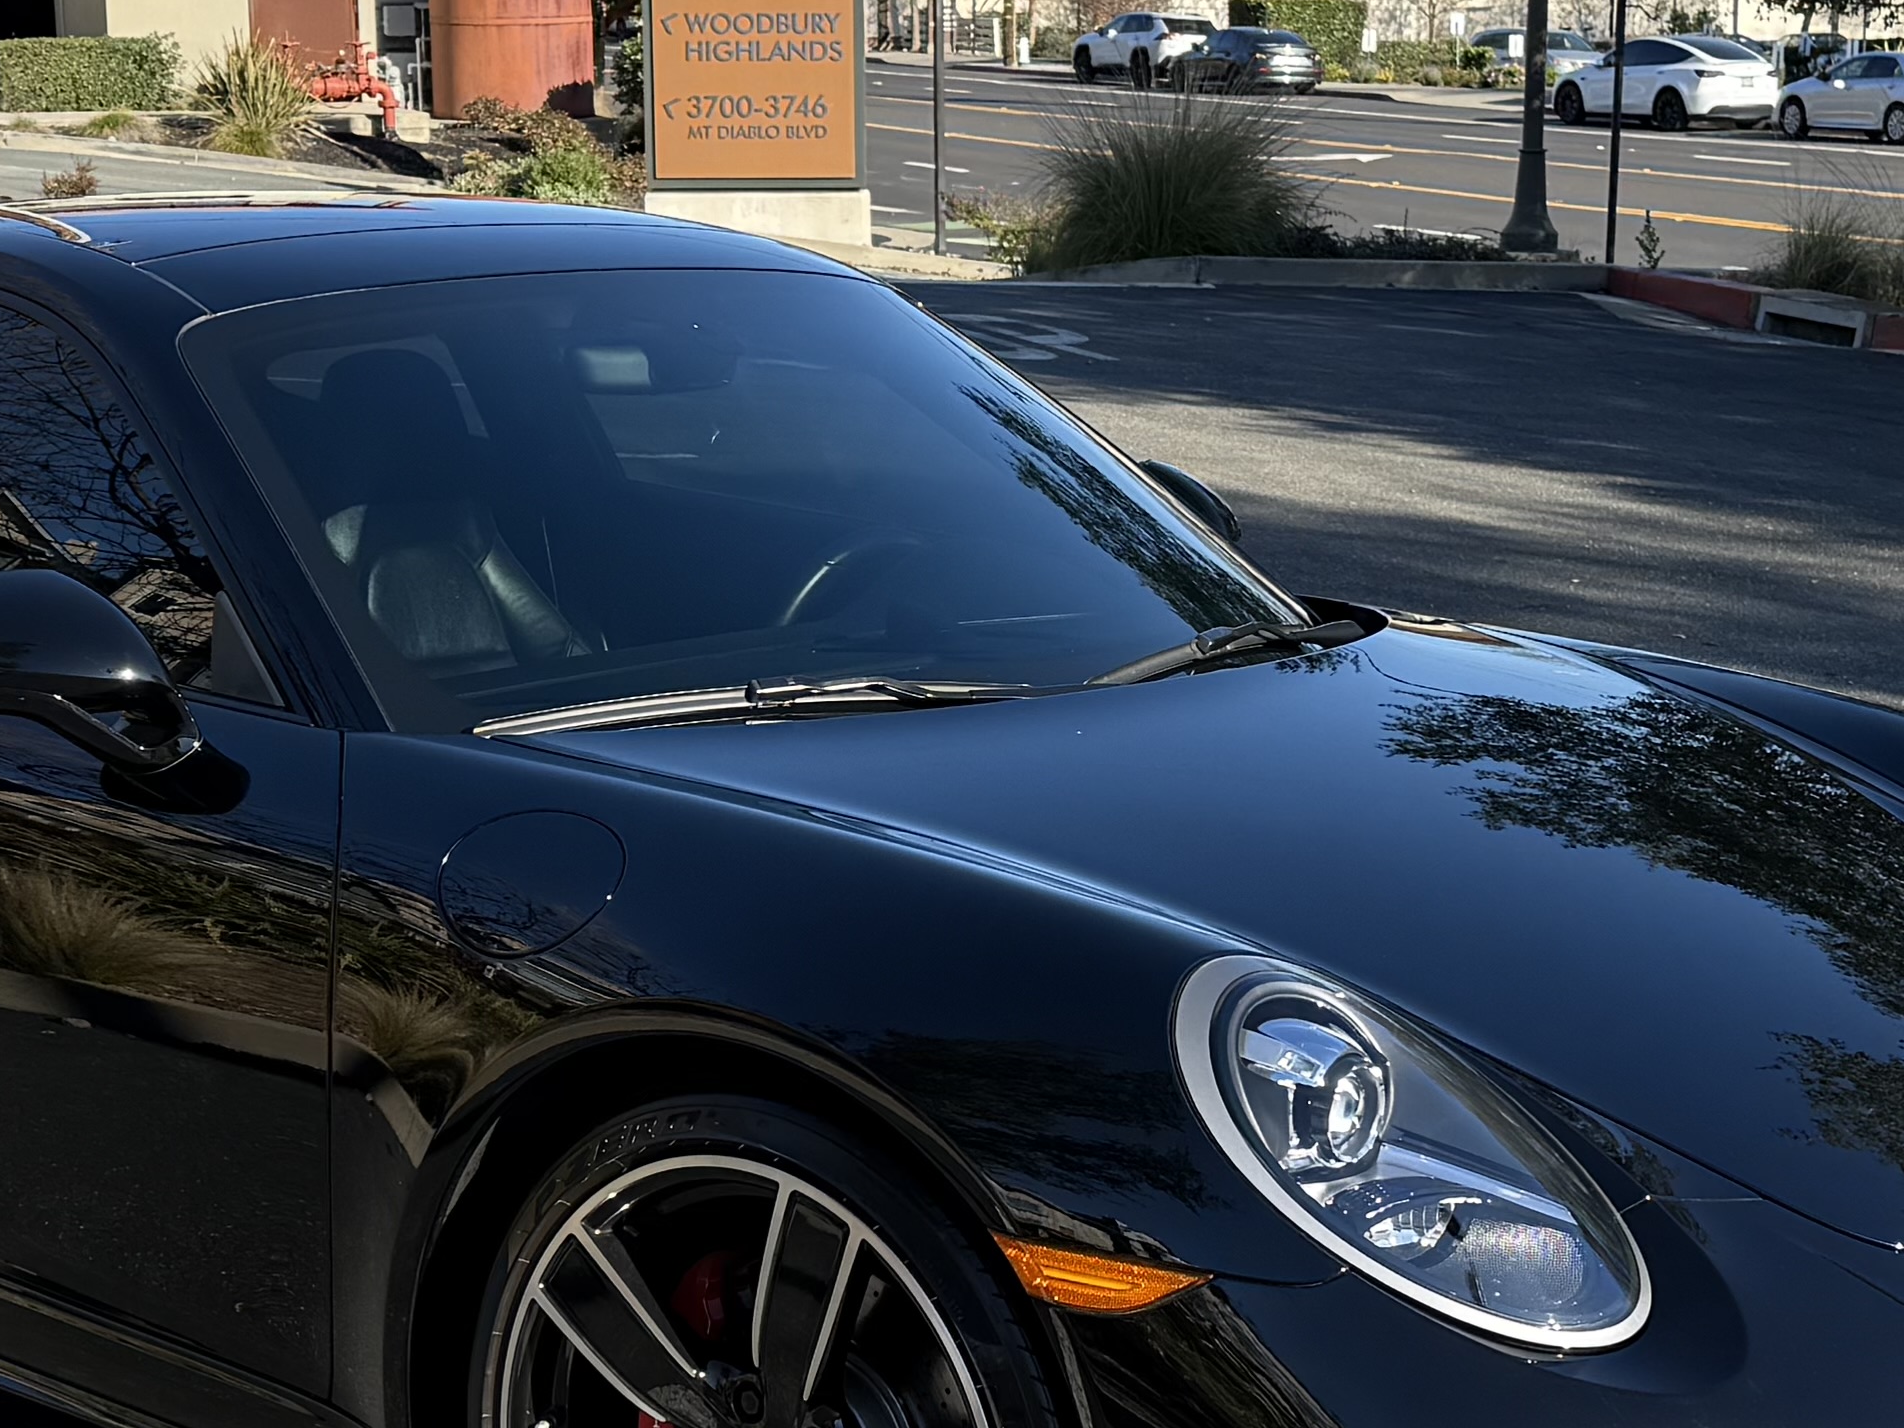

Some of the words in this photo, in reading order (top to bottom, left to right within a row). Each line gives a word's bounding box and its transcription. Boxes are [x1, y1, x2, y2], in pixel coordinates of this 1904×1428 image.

[683, 12, 842, 35] WOODBURY
[684, 40, 843, 63] HIGHLANDS
[686, 94, 829, 119] 3700-3746
[687, 125, 713, 140] MT
[717, 125, 780, 140] DIABLO
[785, 124, 828, 140] BLVD
